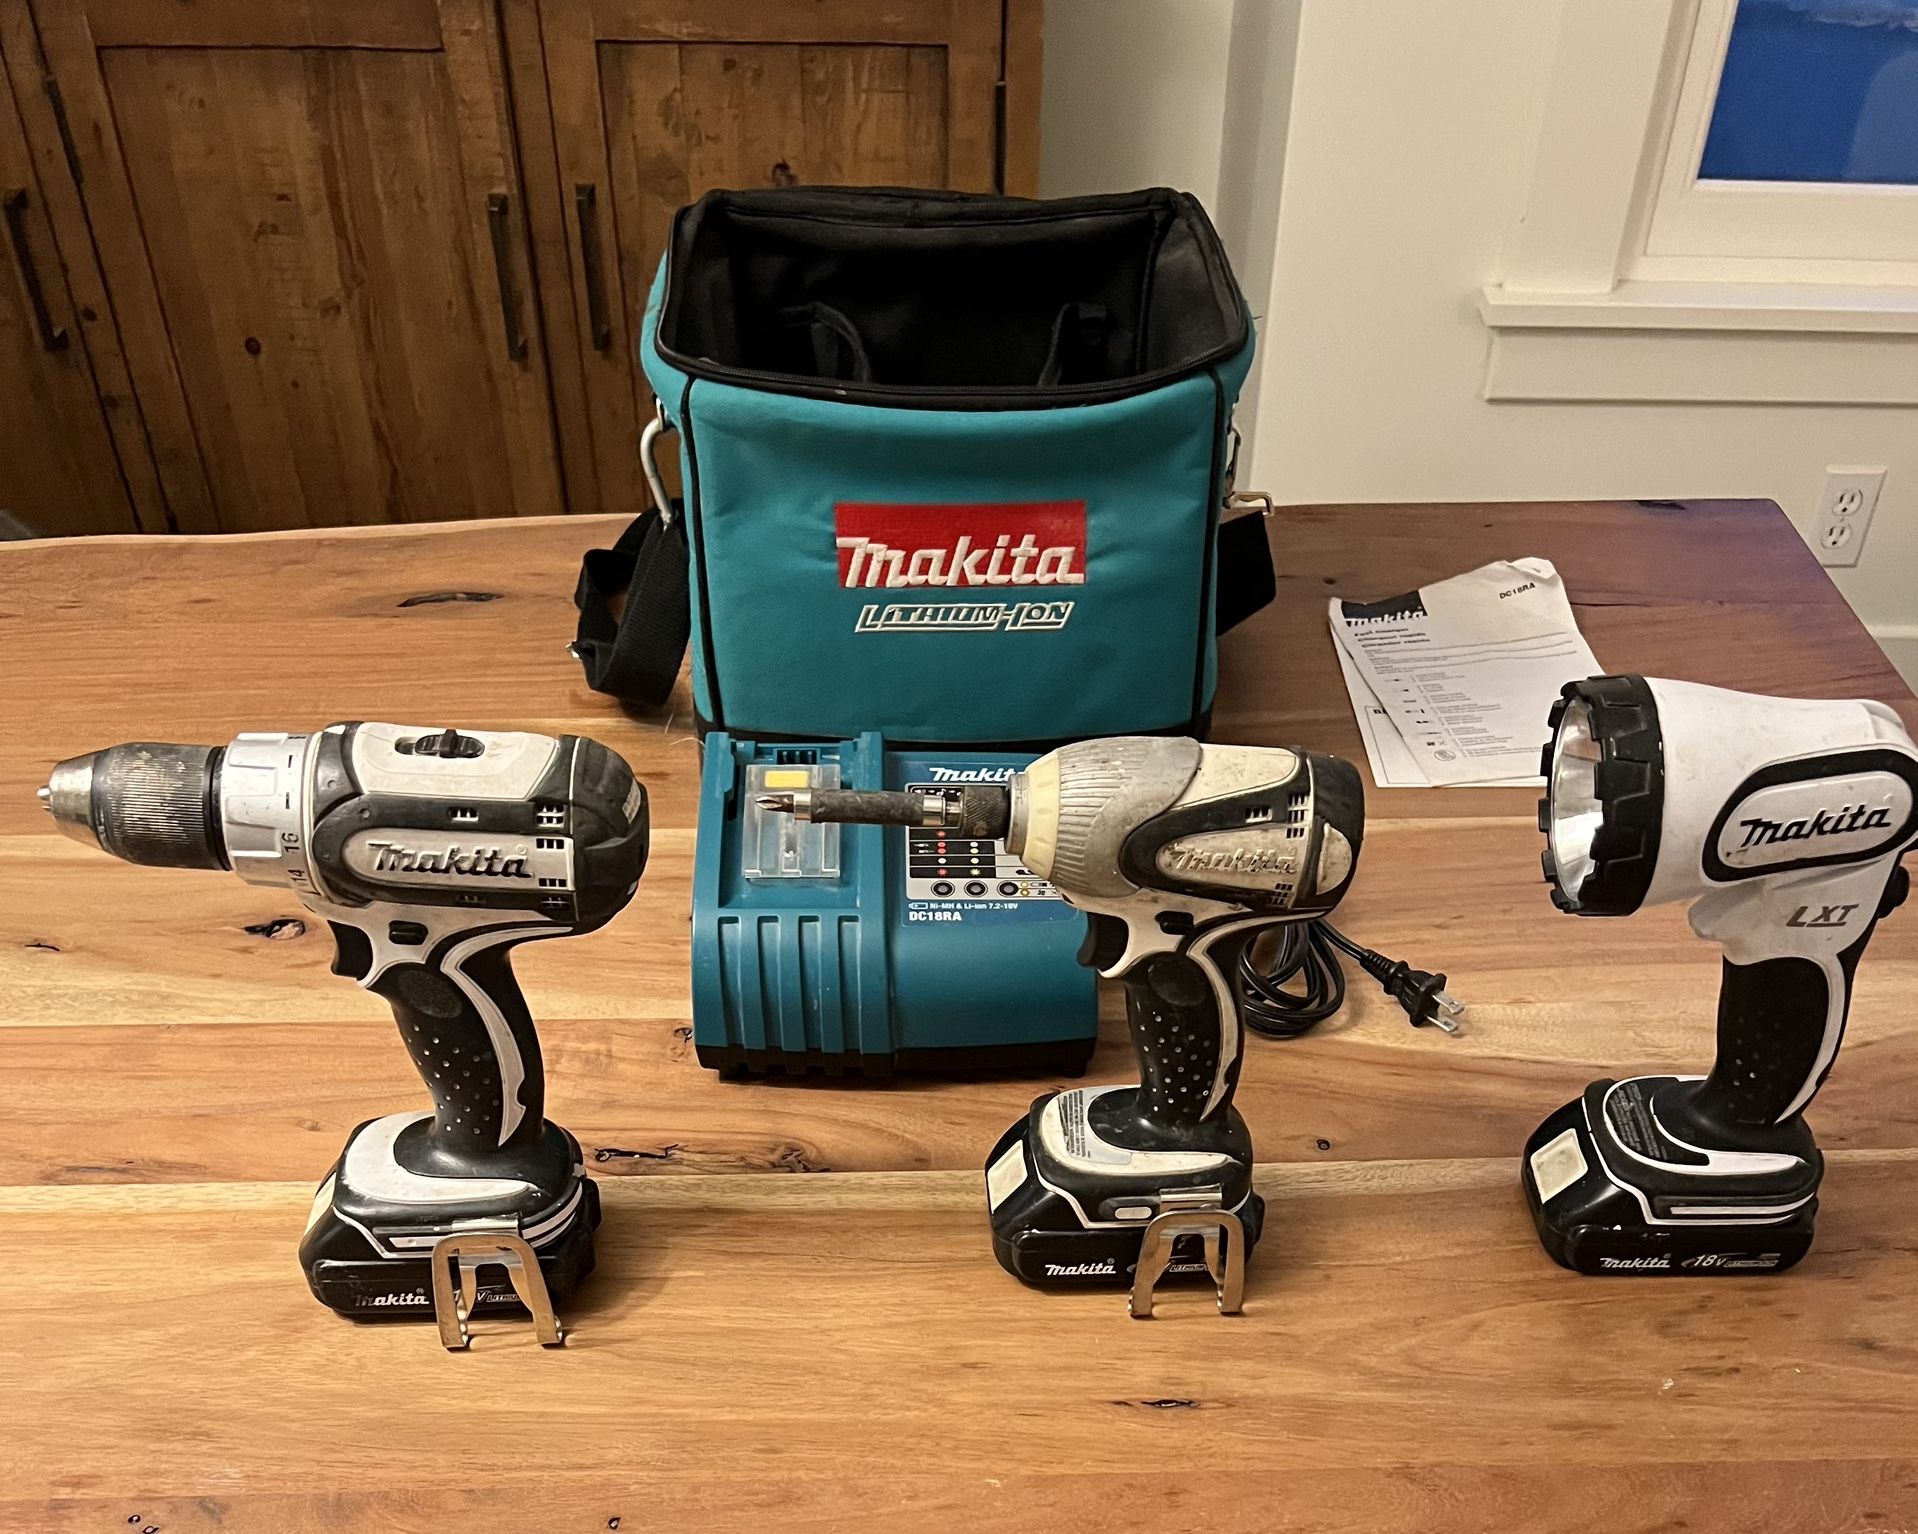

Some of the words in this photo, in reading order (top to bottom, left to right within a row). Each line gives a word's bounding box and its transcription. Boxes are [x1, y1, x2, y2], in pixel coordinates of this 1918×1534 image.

[929, 767, 1025, 782] Makit
[282, 832, 299, 853] 16
[288, 868, 307, 884] 14
[909, 911, 962, 921] DC18RA
[1786, 904, 1859, 928] LXT
